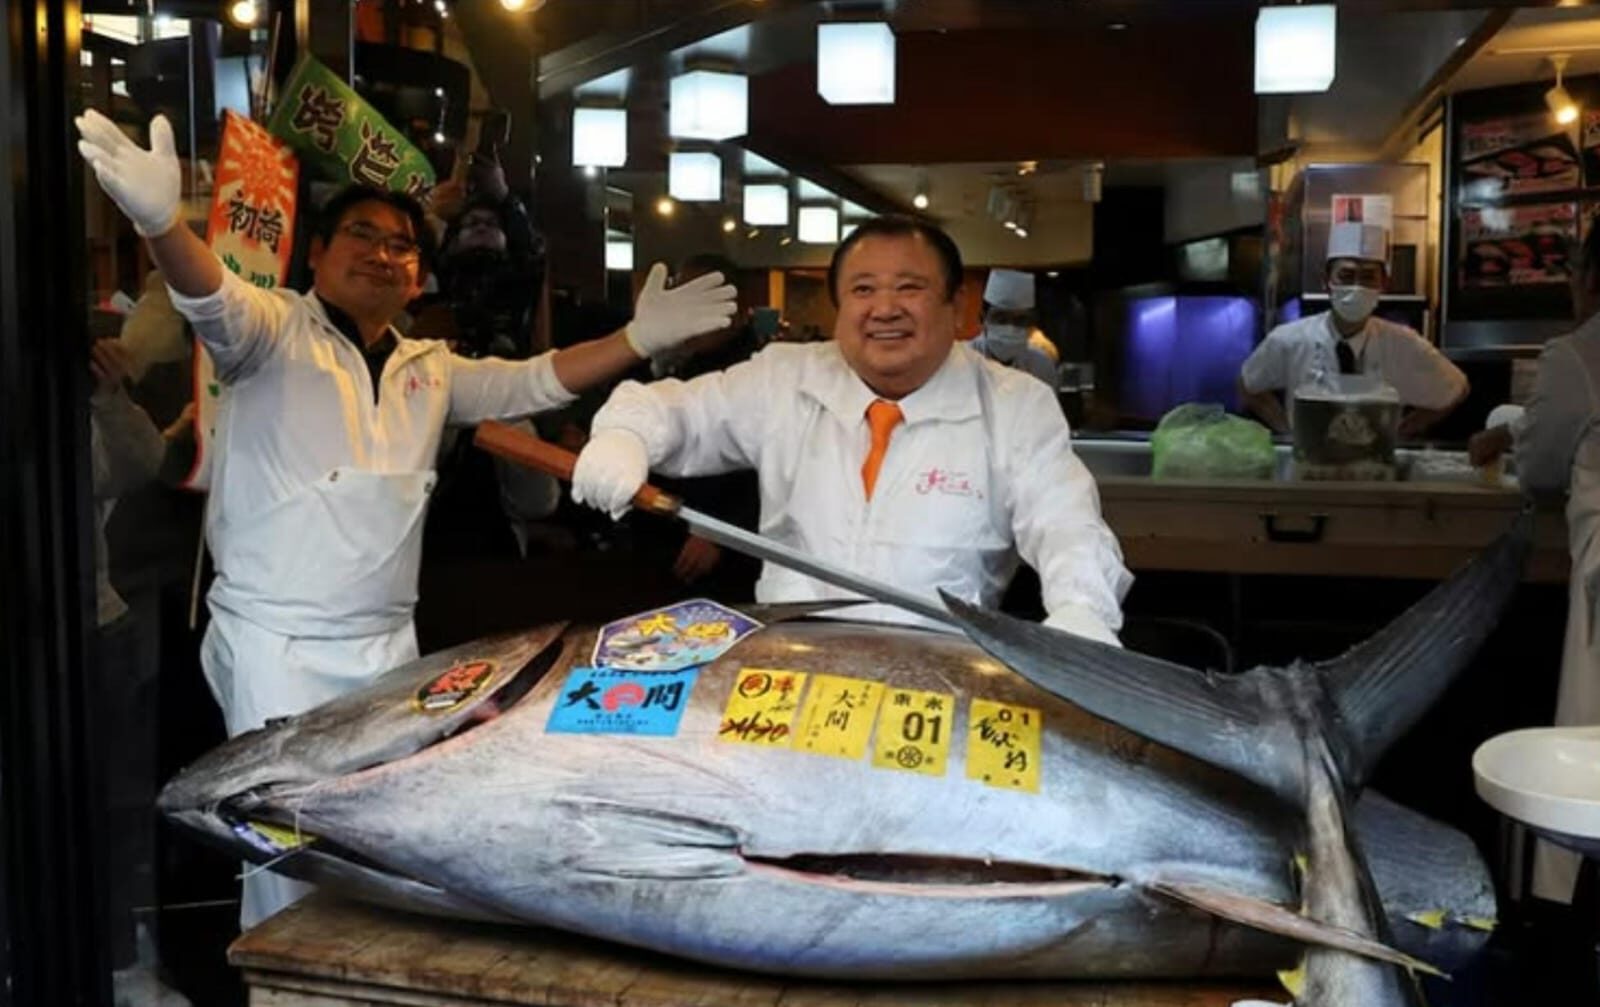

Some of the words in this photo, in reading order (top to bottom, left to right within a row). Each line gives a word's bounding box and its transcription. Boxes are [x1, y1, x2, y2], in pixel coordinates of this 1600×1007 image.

[224, 190, 285, 256] 初荷
[824, 689, 856, 731] 大間
[903, 711, 941, 744] 01
[998, 709, 1030, 725] 01
